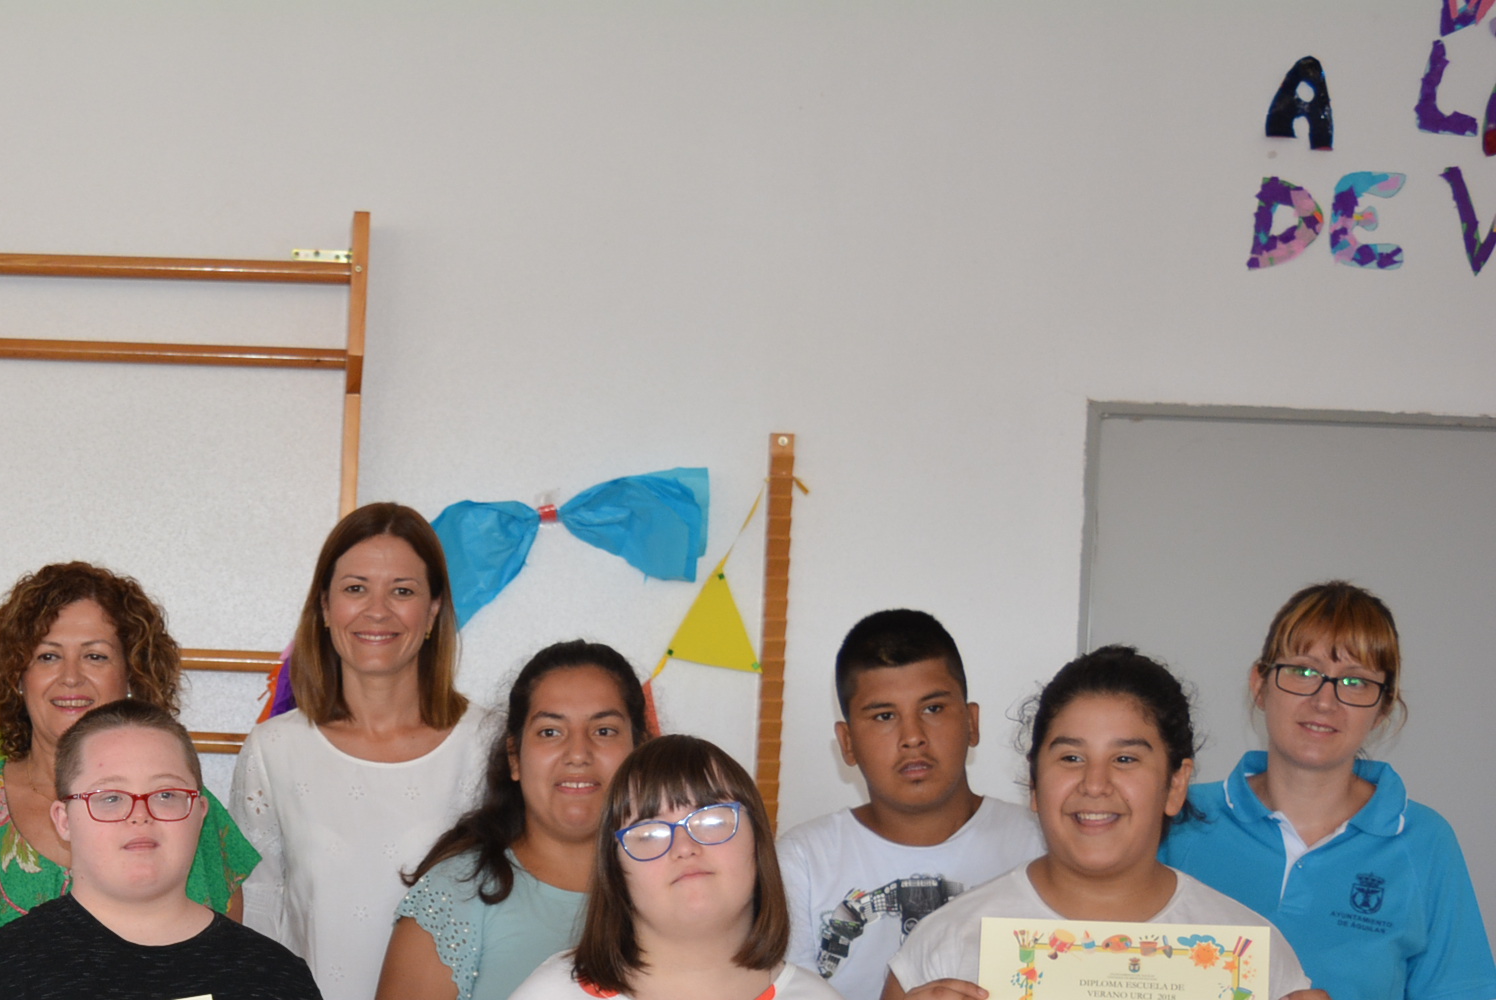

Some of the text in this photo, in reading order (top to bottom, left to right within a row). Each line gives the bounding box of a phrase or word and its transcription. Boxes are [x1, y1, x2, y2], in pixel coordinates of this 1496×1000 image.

[1265, 55, 1334, 151] A
[1246, 171, 1406, 271] DE
[1079, 979, 1185, 991] DIPLOMA ESCUELA DE
[1087, 990, 1128, 999] VERANO
[1130, 991, 1153, 1000] URCI
